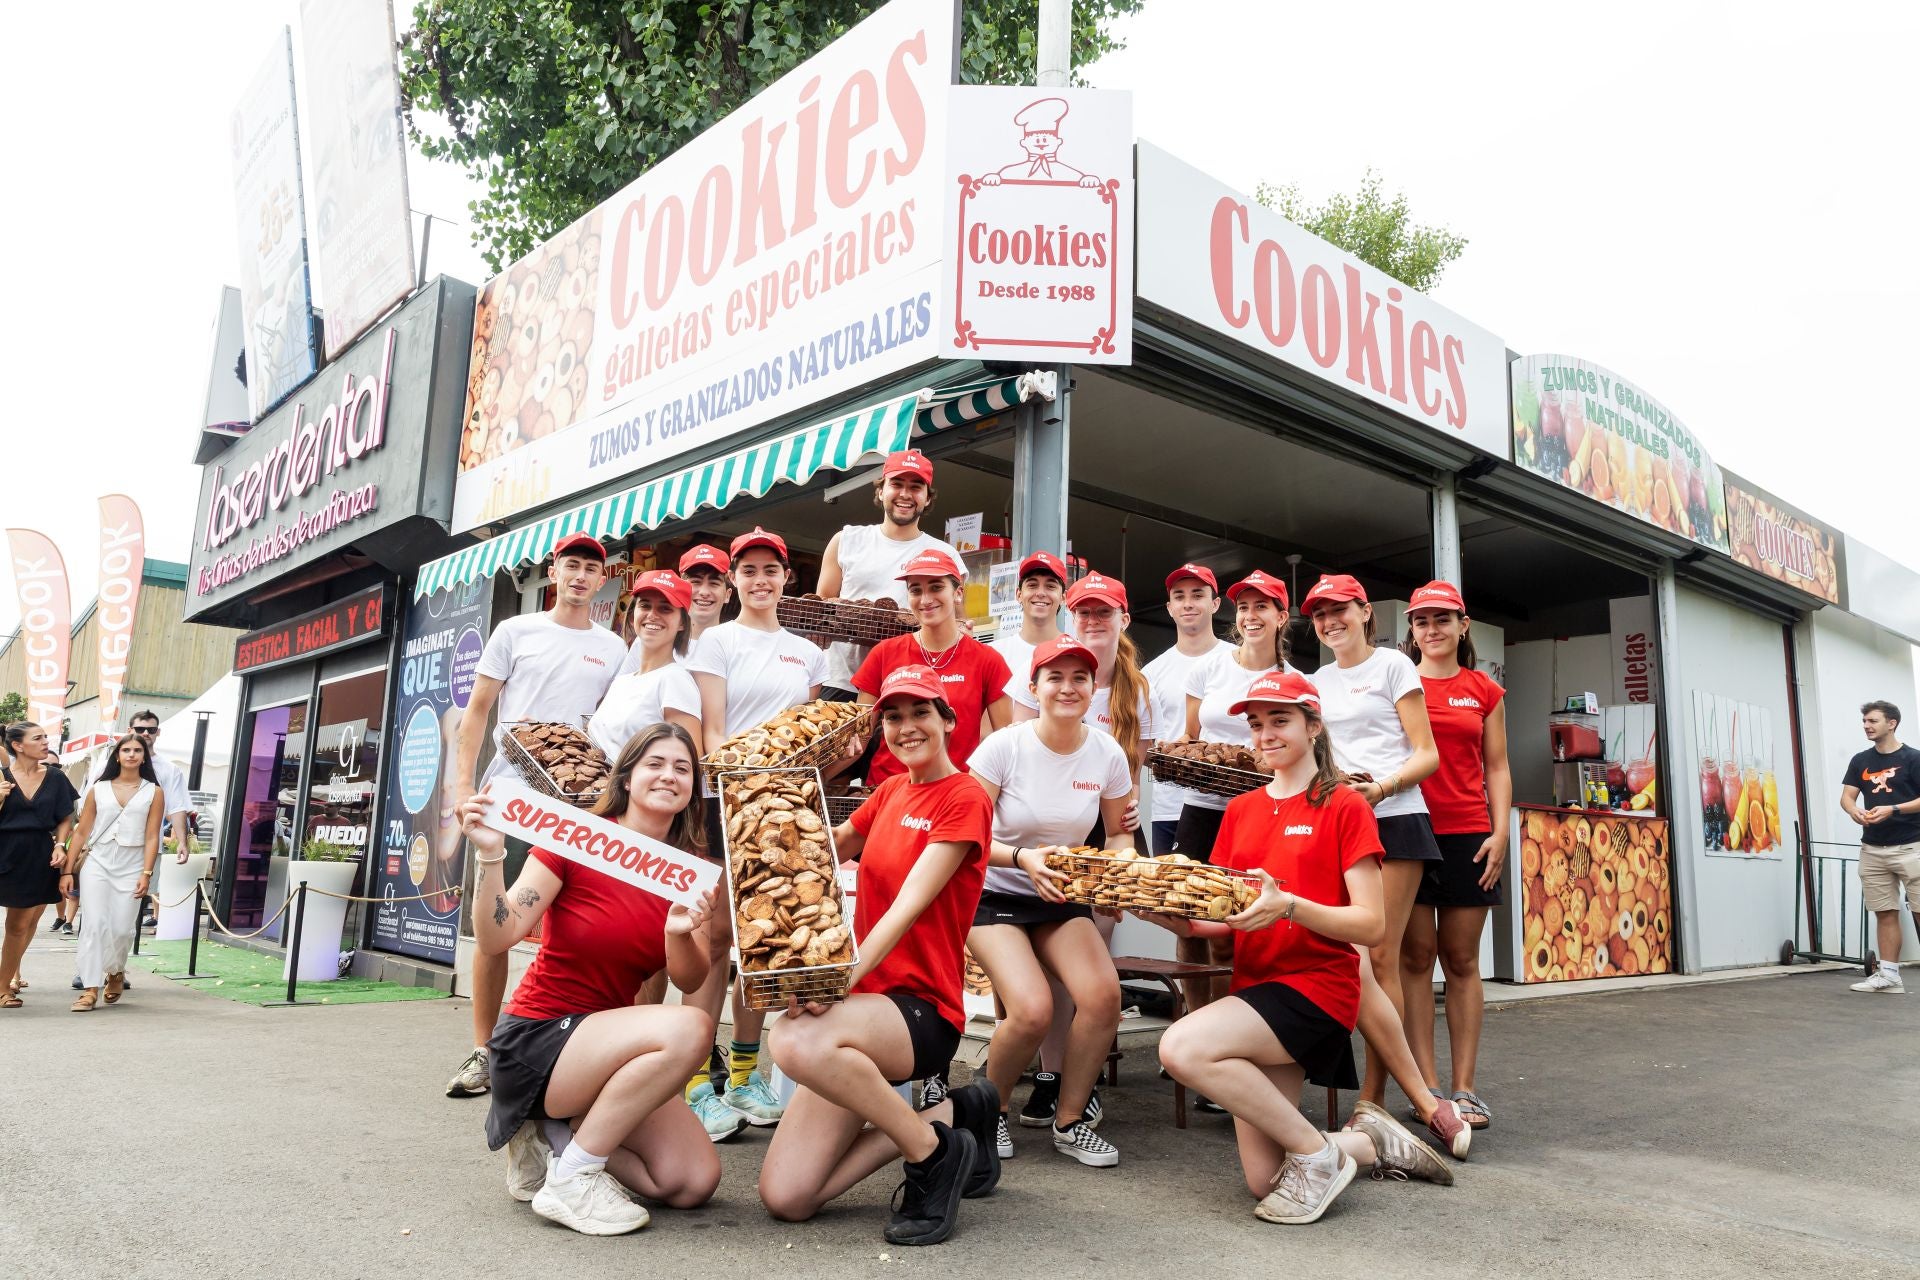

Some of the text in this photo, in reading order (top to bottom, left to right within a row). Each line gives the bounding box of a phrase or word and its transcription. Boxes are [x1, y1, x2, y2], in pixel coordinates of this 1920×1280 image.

[610, 29, 927, 330] Cookies
[968, 222, 1106, 268] Cookies
[603, 198, 916, 402] galletas especiales
[978, 280, 1096, 303] Desde 1988
[1210, 196, 1467, 430] Cookies
[588, 291, 931, 468] ZUMOS Y GRANIZADOS NATURALES
[203, 327, 397, 551] laserdental
[1541, 367, 1701, 470] ZUMOS Y GRANIZADOS
[1585, 397, 1669, 459] NATURALES
[307, 481, 377, 538] confianza
[1754, 513, 1815, 581] COOKIES
[652, 577, 675, 588] Cookies
[237, 632, 290, 669] ESTÉTICA
[296, 613, 340, 654] FACIAL
[348, 605, 359, 636] Y
[406, 628, 456, 658] IMAGINATE
[583, 654, 606, 667] Cookies
[779, 654, 806, 667] Cookies
[940, 674, 965, 683] Cookies
[1623, 632, 1650, 704] alletas
[1448, 697, 1480, 708] Cookies
[1072, 780, 1101, 791] Cookies
[314, 825, 368, 846] PUEDO
[501, 798, 698, 893] SUPERCOOKIES
[1284, 824, 1313, 836] Cookies
